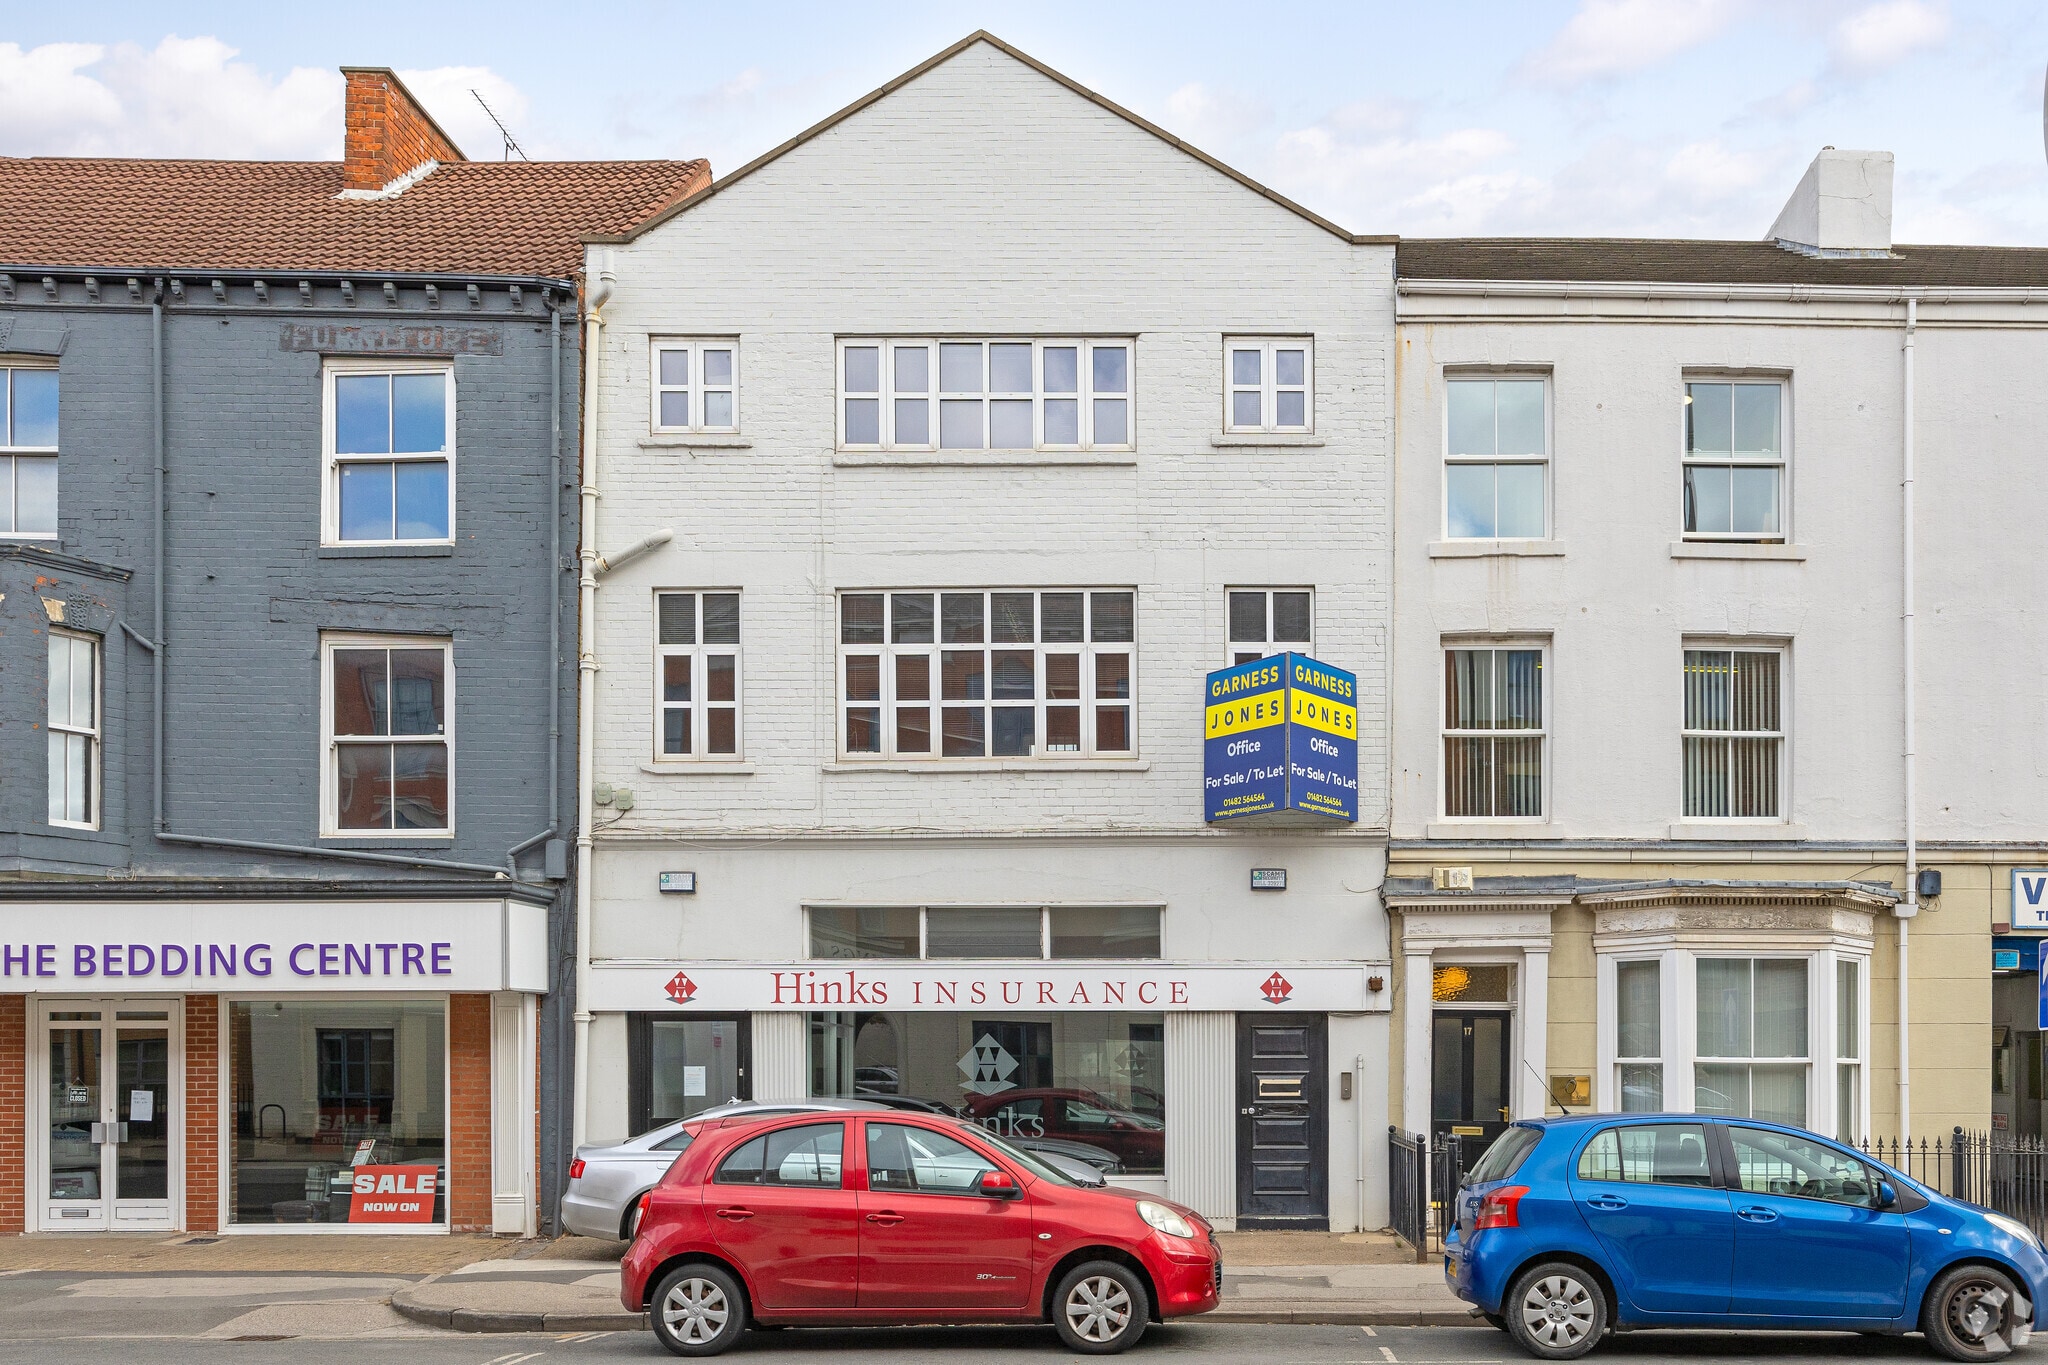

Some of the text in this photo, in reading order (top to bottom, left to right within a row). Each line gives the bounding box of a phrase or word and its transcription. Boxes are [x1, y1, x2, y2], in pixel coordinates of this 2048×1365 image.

[1211, 665, 1279, 697] GARNESS
[1295, 664, 1352, 698] GARNESS
[1211, 699, 1279, 730] JONES
[1296, 699, 1352, 730] JONES
[1227, 740, 1261, 757] Office
[1310, 737, 1339, 758] Office
[1206, 765, 1284, 789] For Sale / To Let
[1291, 763, 1357, 790] For Sale / To Let
[1214, 801, 1275, 818] www.garnessjones.co.uk
[1223, 792, 1265, 807] 01482 564564
[1306, 791, 1342, 807] 01482 564564
[74, 942, 272, 977] BEDDING
[289, 942, 452, 977] CENTRE
[770, 971, 1189, 1005] Hinks INSURANCE
[1464, 1027, 1473, 1036] 17
[354, 1174, 436, 1194] SALE
[363, 1202, 420, 1212] NOW ON
